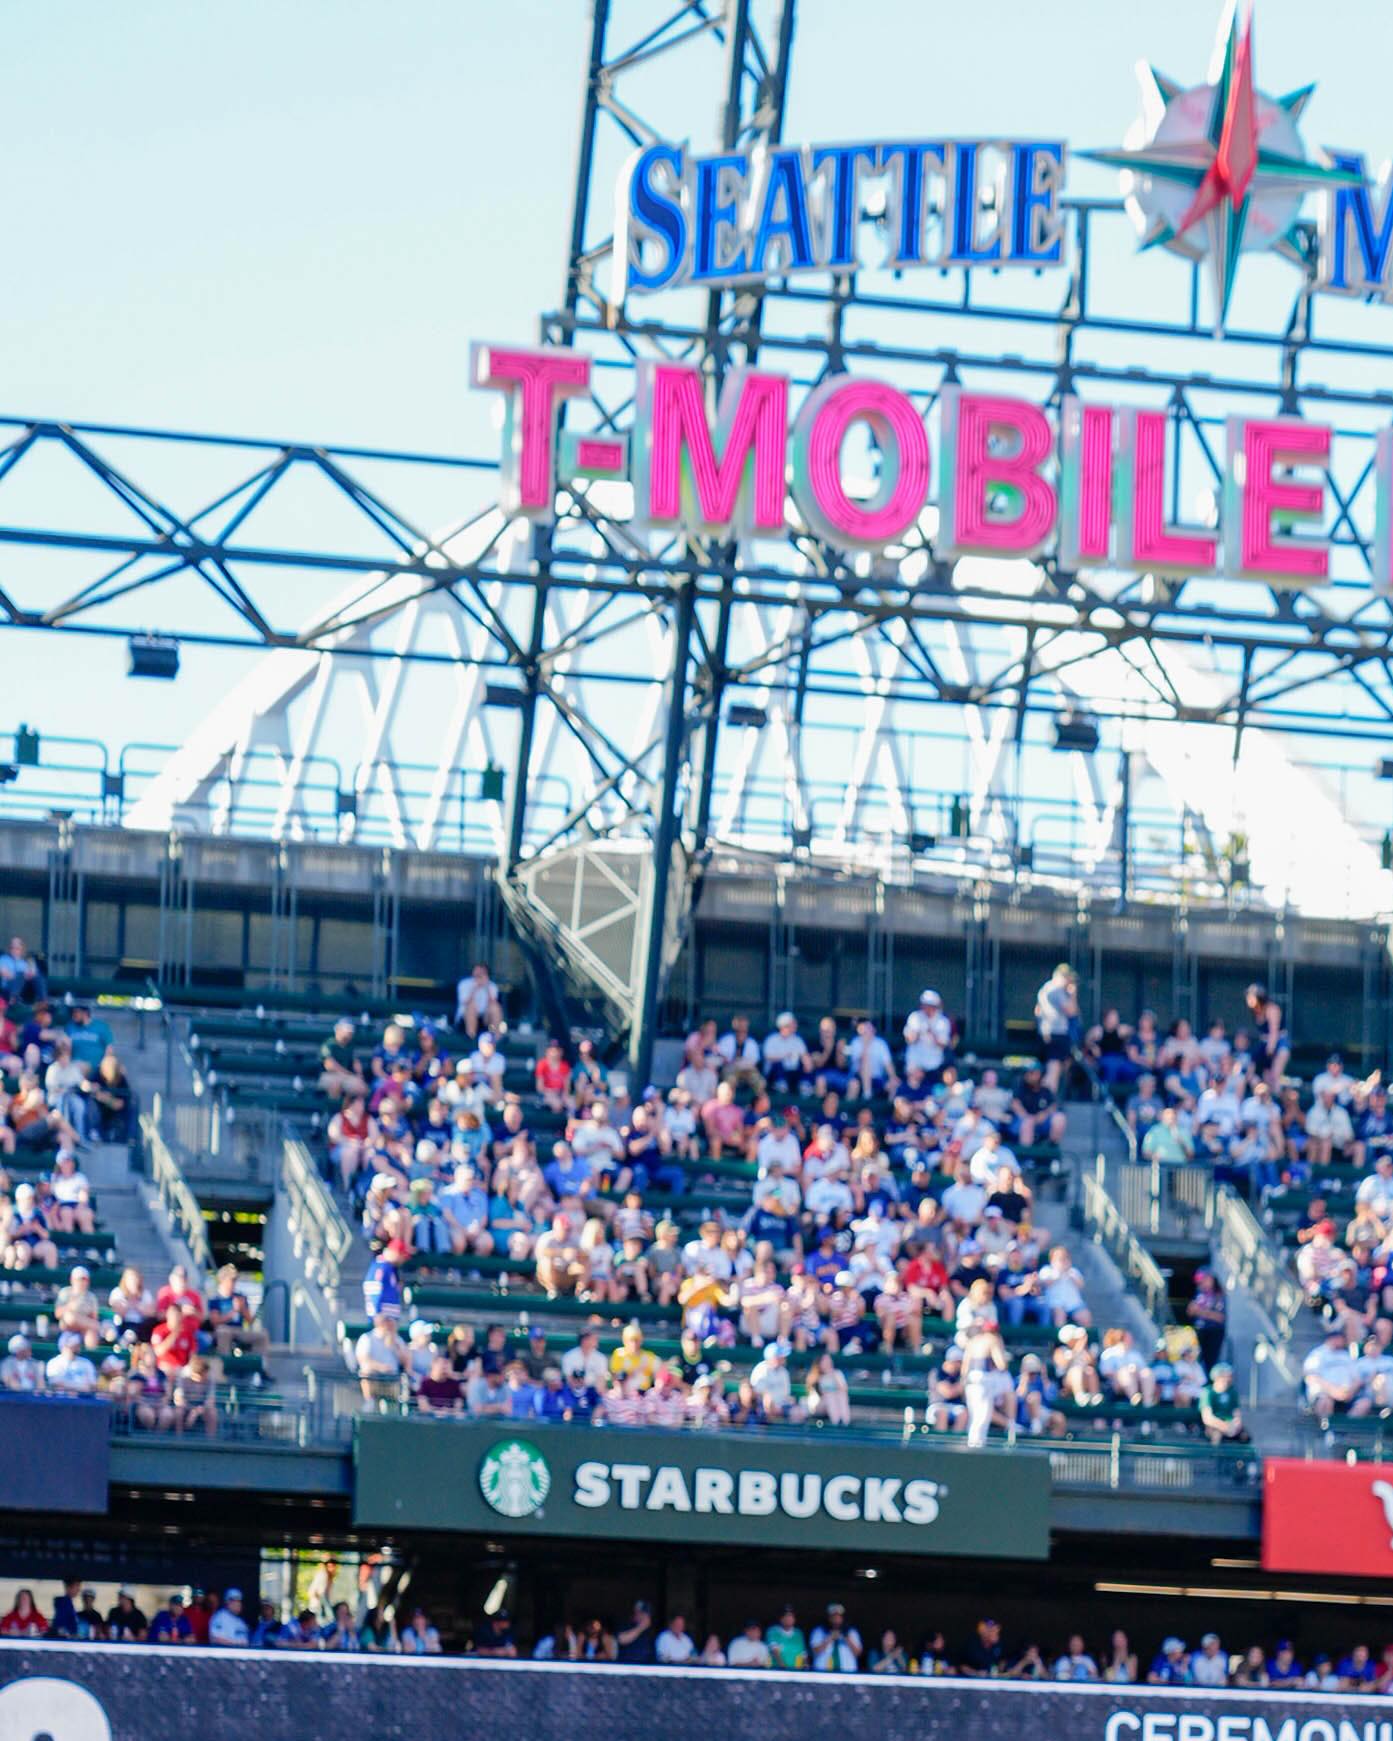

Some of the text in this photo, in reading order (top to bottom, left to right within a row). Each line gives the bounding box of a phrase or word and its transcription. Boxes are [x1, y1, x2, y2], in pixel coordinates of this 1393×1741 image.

[620, 138, 1067, 292] SEATTLE
[472, 341, 1334, 580] T-MOBILE
[574, 1461, 940, 1525] STARBUCKS
